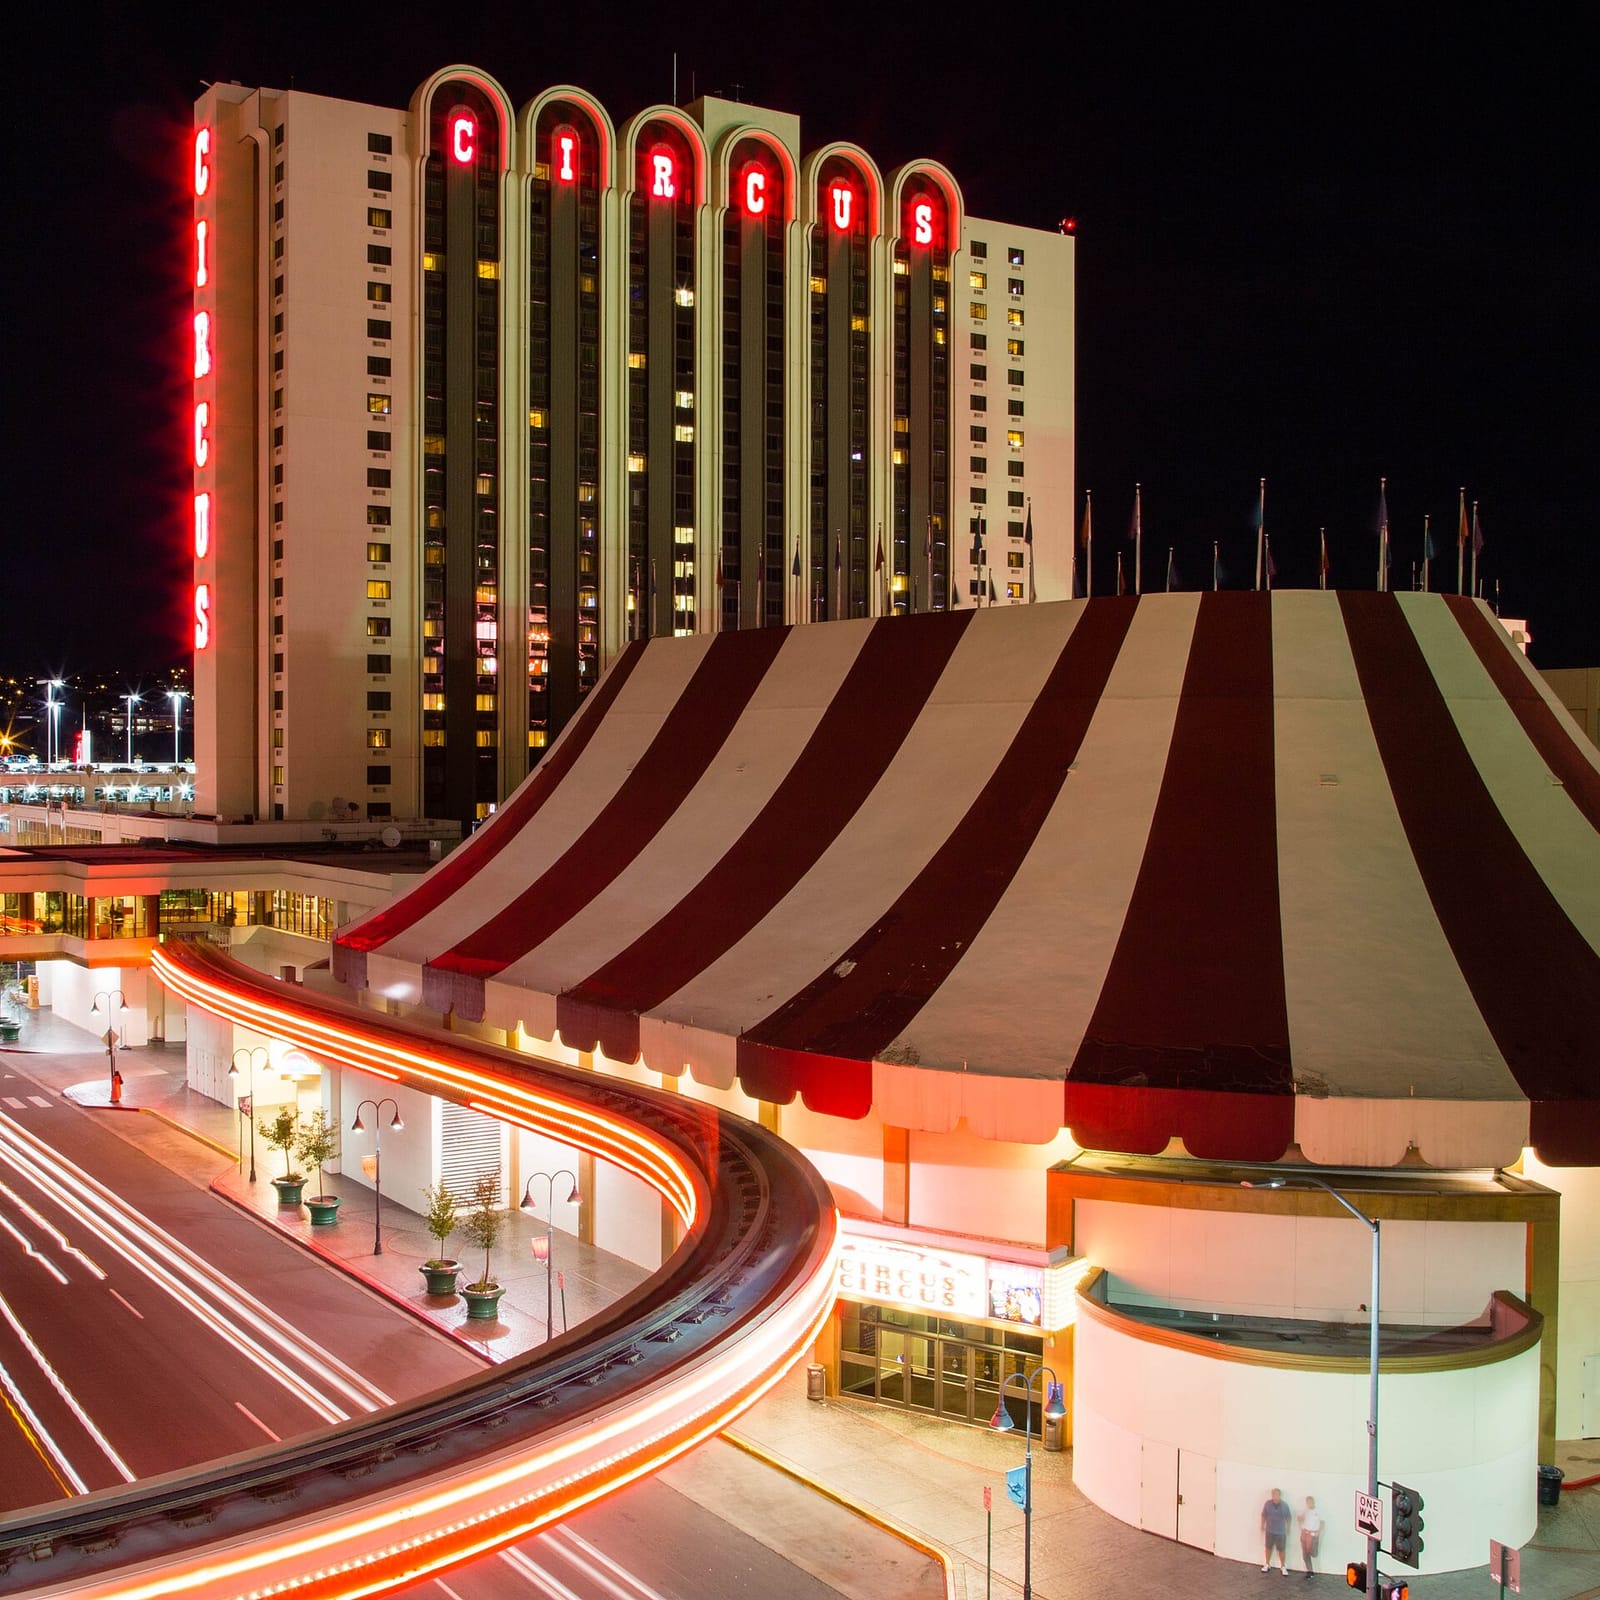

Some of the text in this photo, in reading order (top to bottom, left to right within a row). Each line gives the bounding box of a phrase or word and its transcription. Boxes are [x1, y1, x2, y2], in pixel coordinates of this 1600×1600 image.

[452, 118, 933, 244] CIRCUS
[193, 127, 211, 650] CIRCUS
[839, 1258, 955, 1291] CIRCUS
[839, 1273, 955, 1307] CIRCUS
[1359, 1506, 1379, 1522] WAY
[1360, 1496, 1378, 1512] ONE
